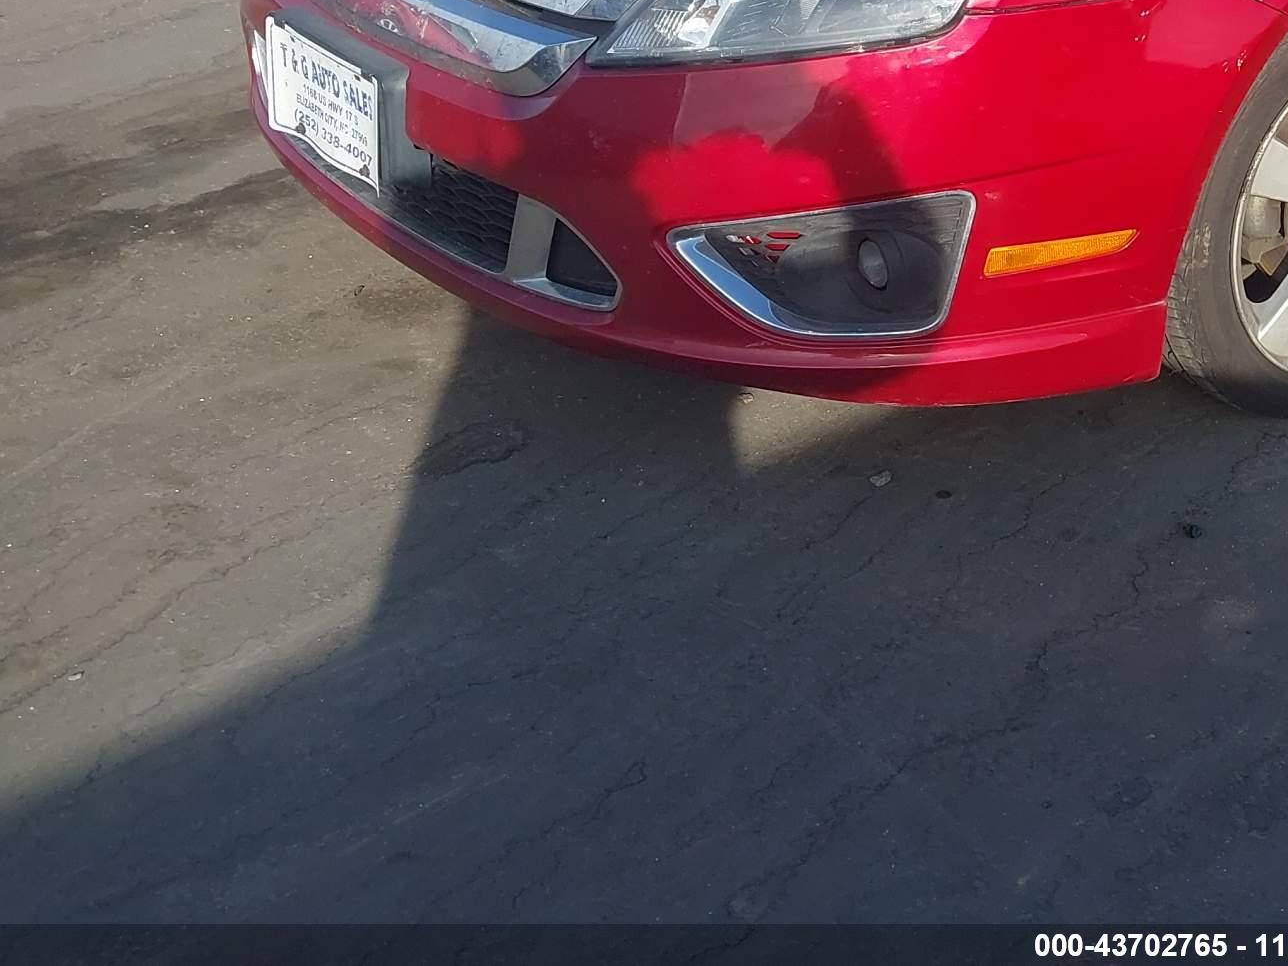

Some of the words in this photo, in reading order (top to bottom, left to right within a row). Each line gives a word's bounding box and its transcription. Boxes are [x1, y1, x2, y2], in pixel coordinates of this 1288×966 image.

[280, 42, 288, 67] T
[291, 48, 299, 74] &
[301, 55, 309, 79] G
[311, 60, 340, 99] AUTO
[343, 80, 373, 121] SALES
[296, 93, 324, 121] ELIZABETH
[324, 112, 338, 131] CITY,
[318, 94, 327, 107] US
[328, 99, 343, 117] HWY
[345, 109, 353, 122] 17
[294, 108, 319, 137] (252)
[321, 128, 373, 166] 338-4007
